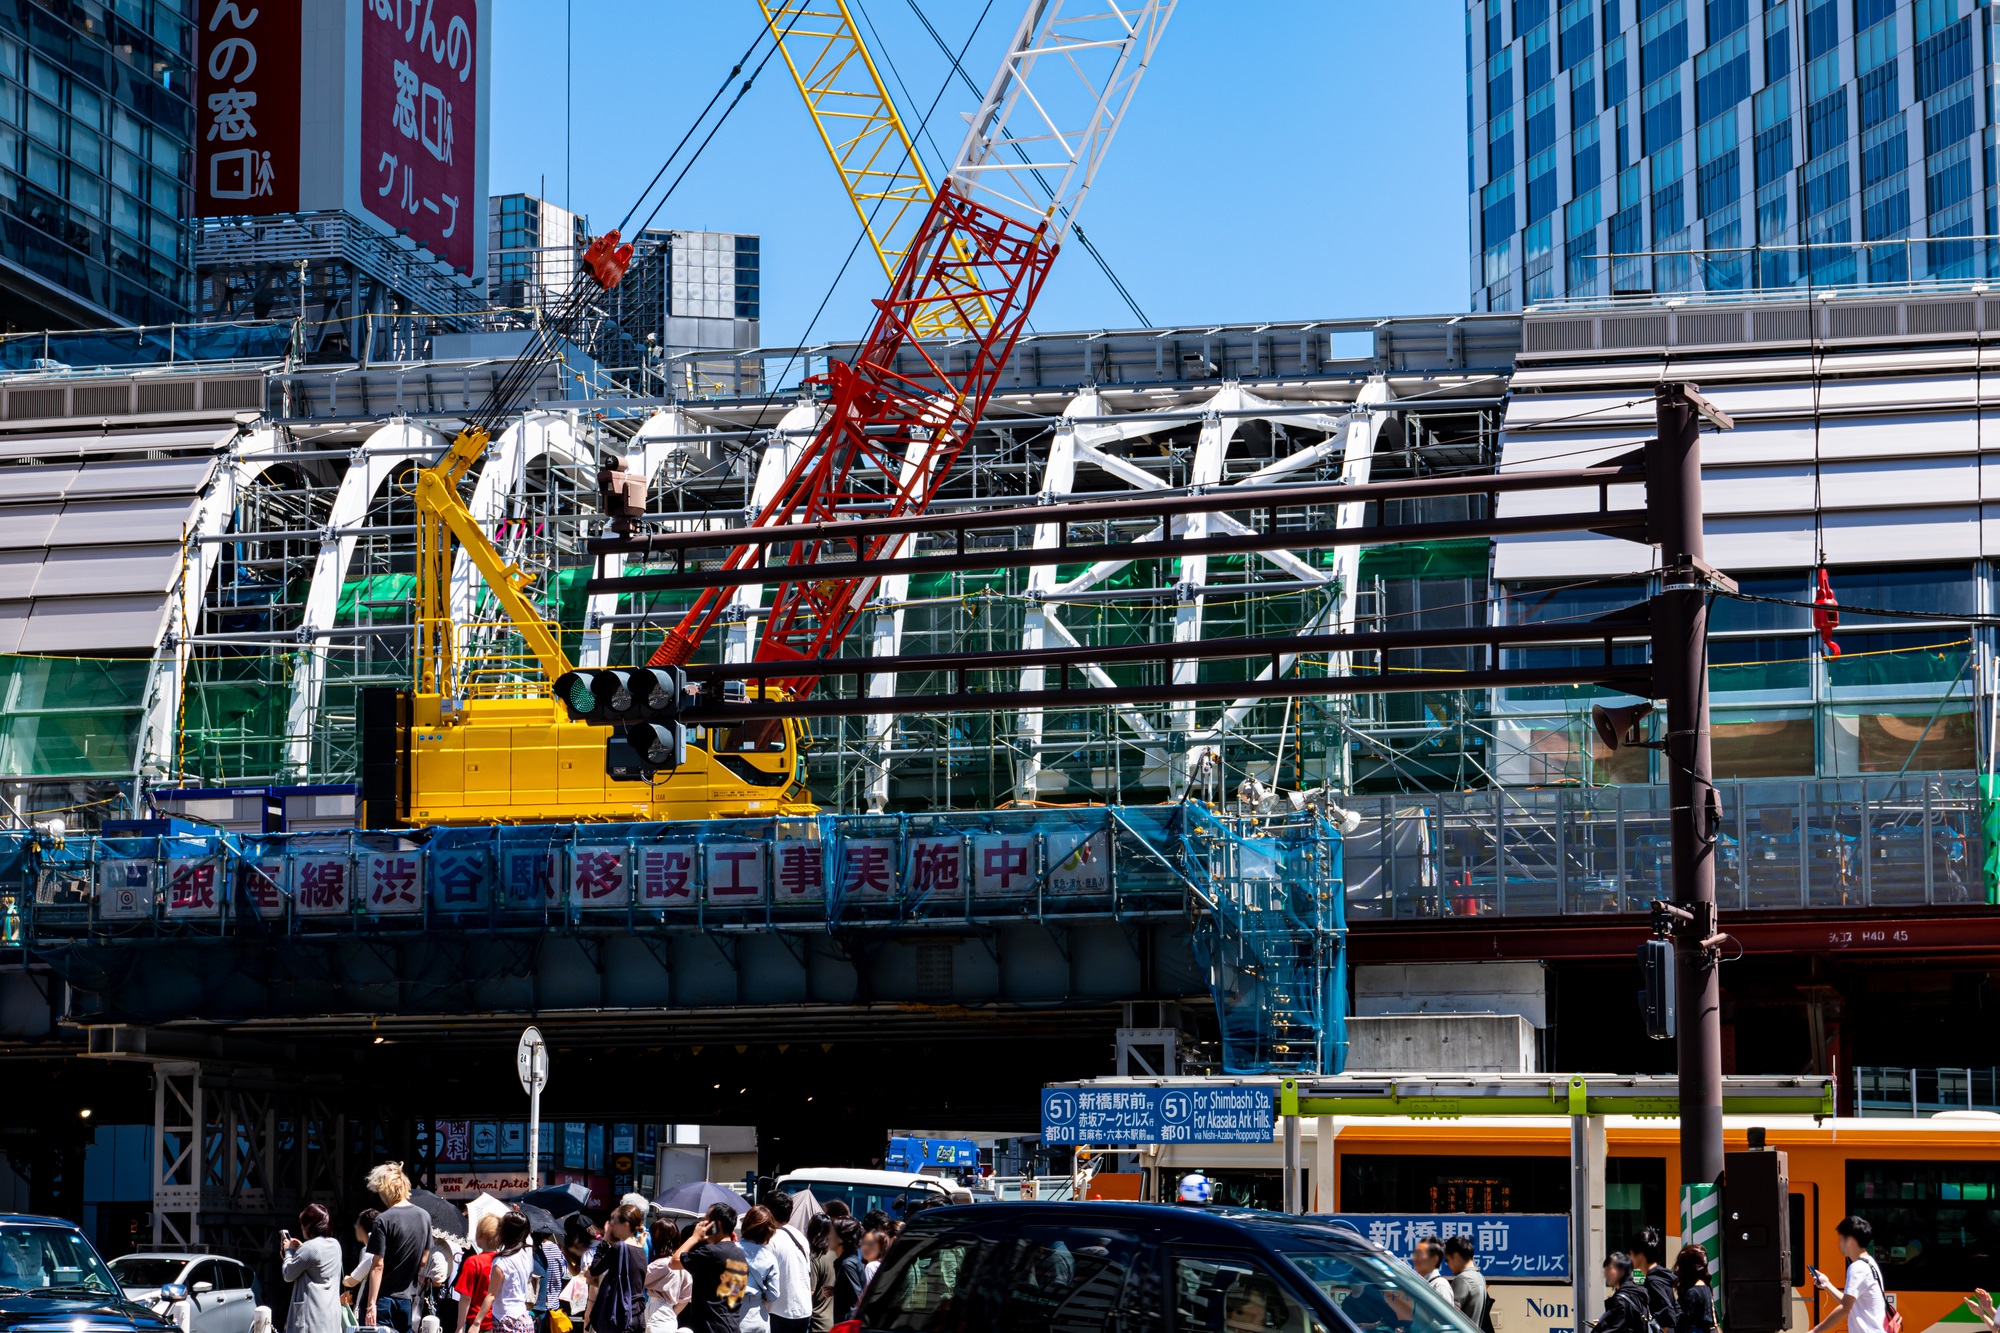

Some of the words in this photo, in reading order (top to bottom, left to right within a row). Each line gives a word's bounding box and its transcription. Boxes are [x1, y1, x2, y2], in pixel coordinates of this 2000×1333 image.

[379, 151, 459, 238] グループ
[171, 839, 1027, 909] 銀座線渋谷駅移設工事実施中
[1049, 1099, 1071, 1119] 51
[1164, 1098, 1187, 1118] 51
[1193, 1091, 1208, 1110] For
[1209, 1090, 1253, 1110] Shimbashi
[1255, 1090, 1271, 1109] Sta.
[1193, 1110, 1206, 1129] For
[1206, 1109, 1237, 1129] Akasaka
[1238, 1109, 1252, 1129] Ark
[1253, 1109, 1271, 1129] Hills.
[1045, 1125, 1075, 1141] 都01
[1160, 1124, 1191, 1141] 都01
[1193, 1130, 1202, 1140] via
[1261, 1129, 1271, 1140] Sta.
[440, 1177, 463, 1185] WINE
[614, 1174, 633, 1185] 2F
[443, 1185, 461, 1193] BAR
